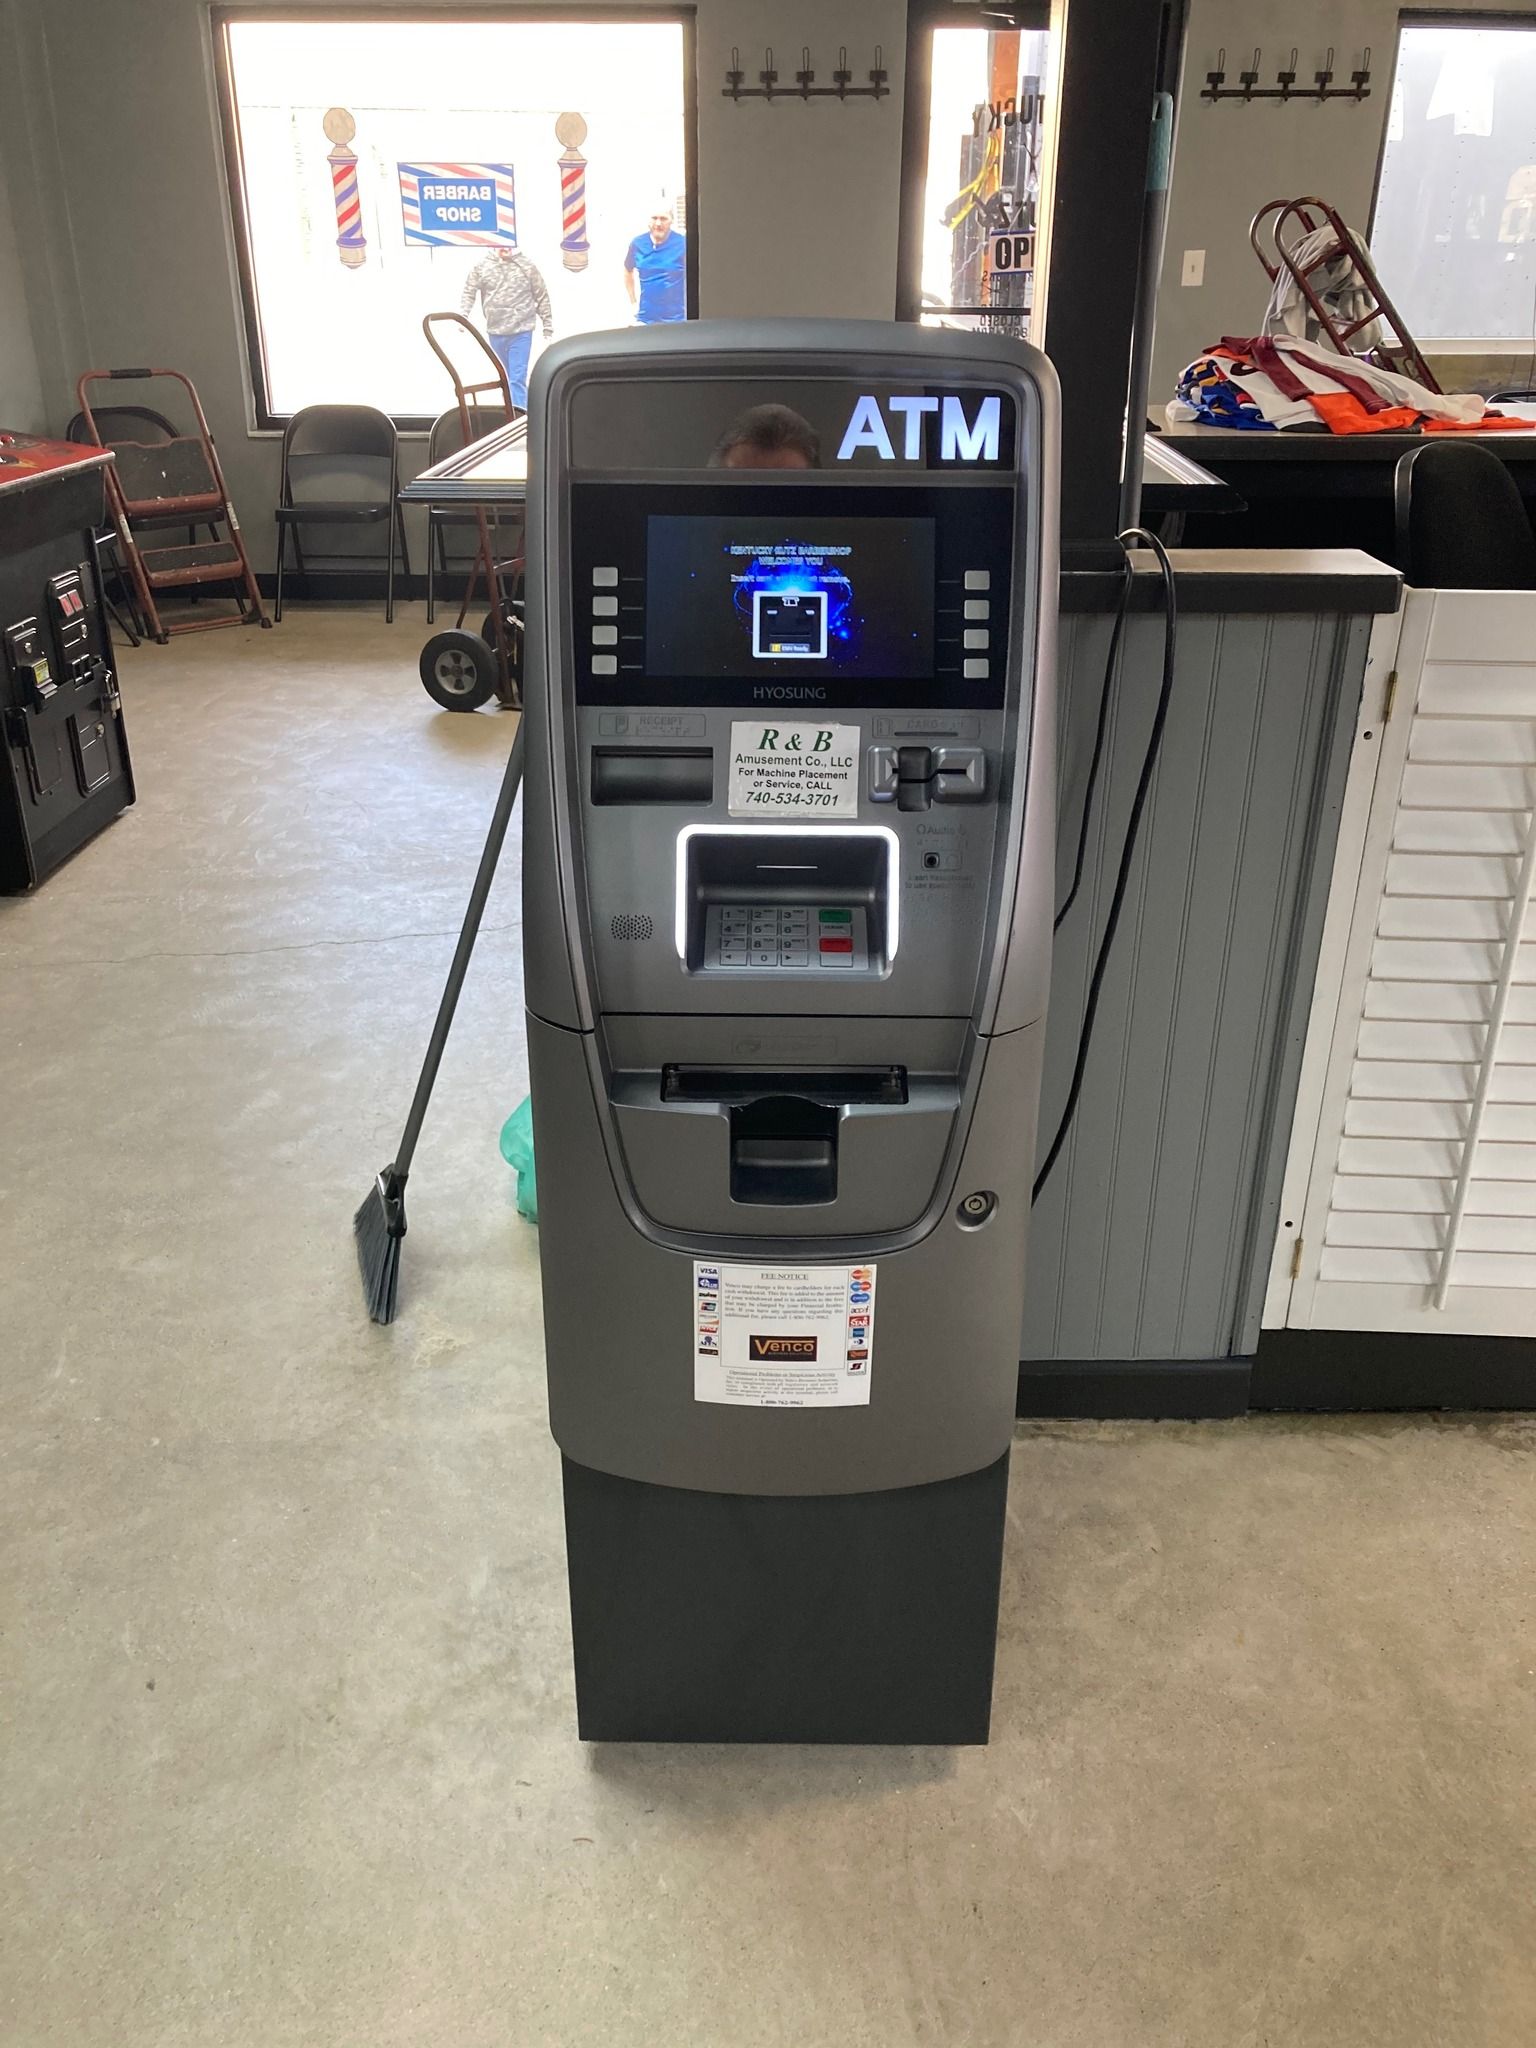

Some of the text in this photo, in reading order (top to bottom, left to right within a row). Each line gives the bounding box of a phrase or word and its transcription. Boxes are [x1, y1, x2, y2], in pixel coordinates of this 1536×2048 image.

[837, 395, 1000, 460] ATM
[753, 687, 826, 699] HYOSUNG
[757, 729, 833, 752] R & B
[735, 754, 853, 768] Amusement Co., LLC
[738, 768, 848, 780] For Machine Placement
[766, 780, 803, 790] Service,
[807, 781, 832, 790] CALL
[745, 792, 838, 806] 740-534-3701
[755, 1339, 815, 1355] Venco
